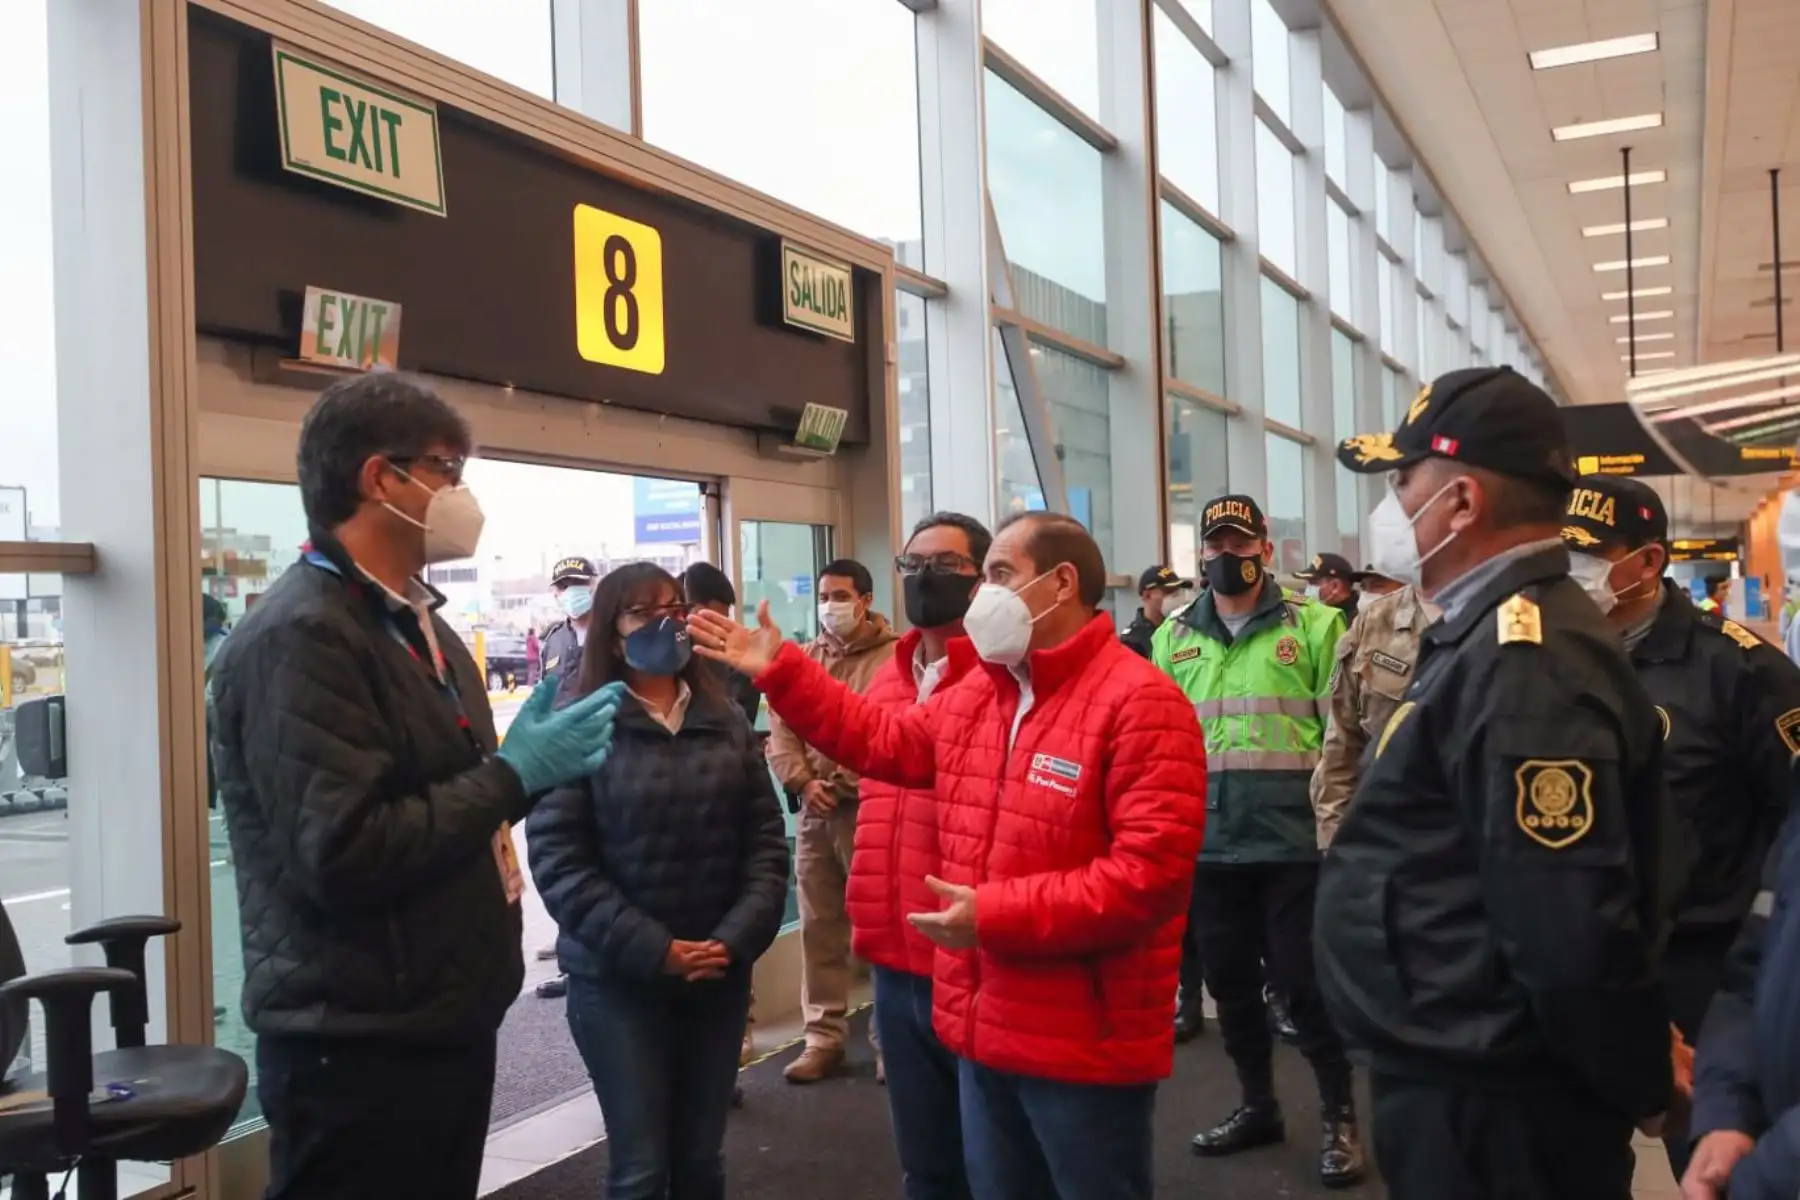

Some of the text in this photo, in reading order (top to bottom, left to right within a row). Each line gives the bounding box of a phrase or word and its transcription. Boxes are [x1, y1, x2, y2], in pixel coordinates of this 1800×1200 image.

[319, 85, 402, 179] EXIT
[603, 234, 639, 351] 8
[790, 260, 848, 322] SALIDA
[316, 294, 387, 364] EXIT
[1206, 500, 1252, 526] POLICIA
[1566, 488, 1616, 527] ICIA
[554, 559, 584, 577] POLICIA
